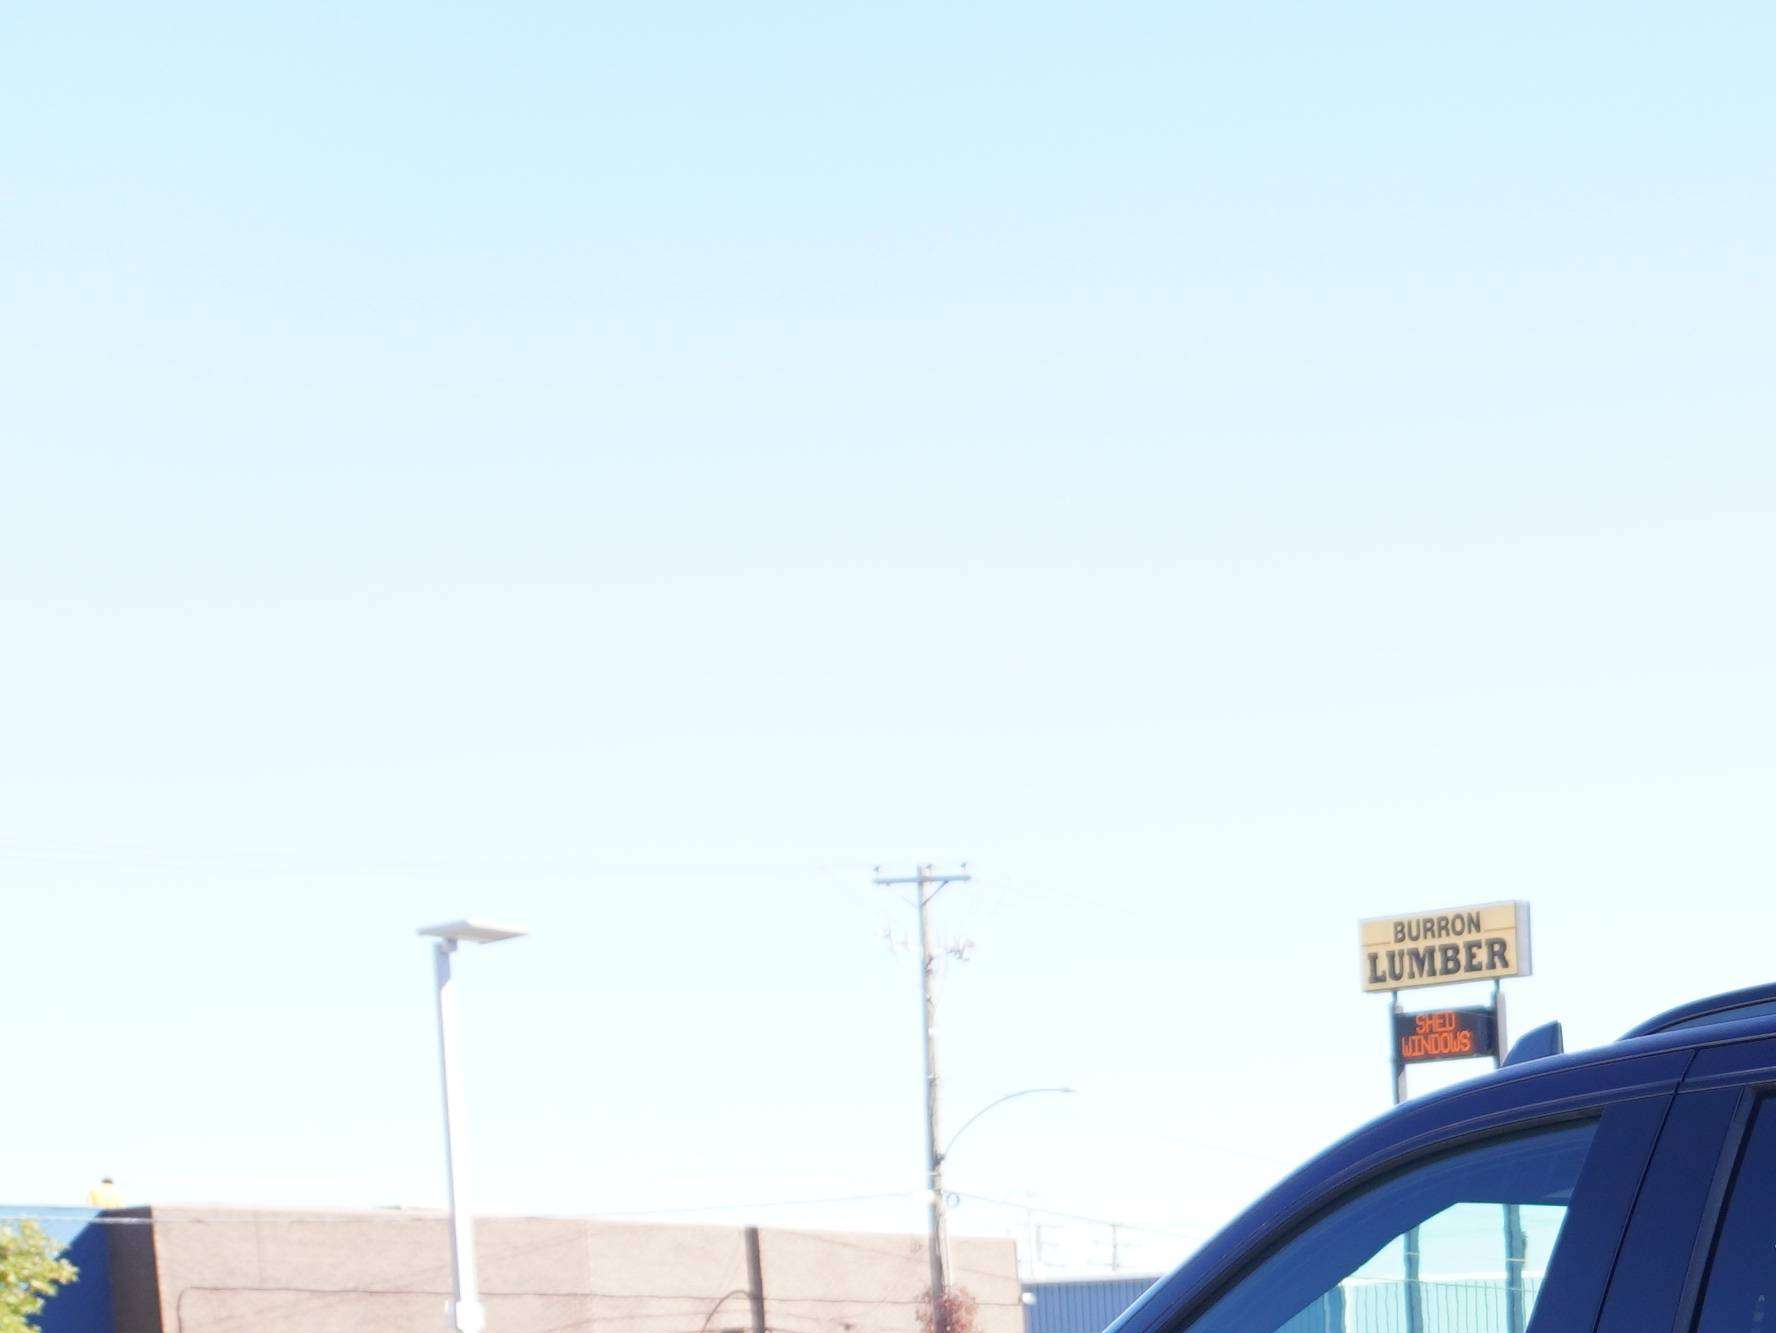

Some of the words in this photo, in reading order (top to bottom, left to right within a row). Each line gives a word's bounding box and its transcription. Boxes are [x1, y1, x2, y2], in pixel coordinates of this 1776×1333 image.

[1392, 910, 1482, 944] BURRON
[1367, 936, 1510, 984] LUMBER
[1415, 1011, 1456, 1034] SHED
[1401, 1030, 1472, 1057] WINDOWS
